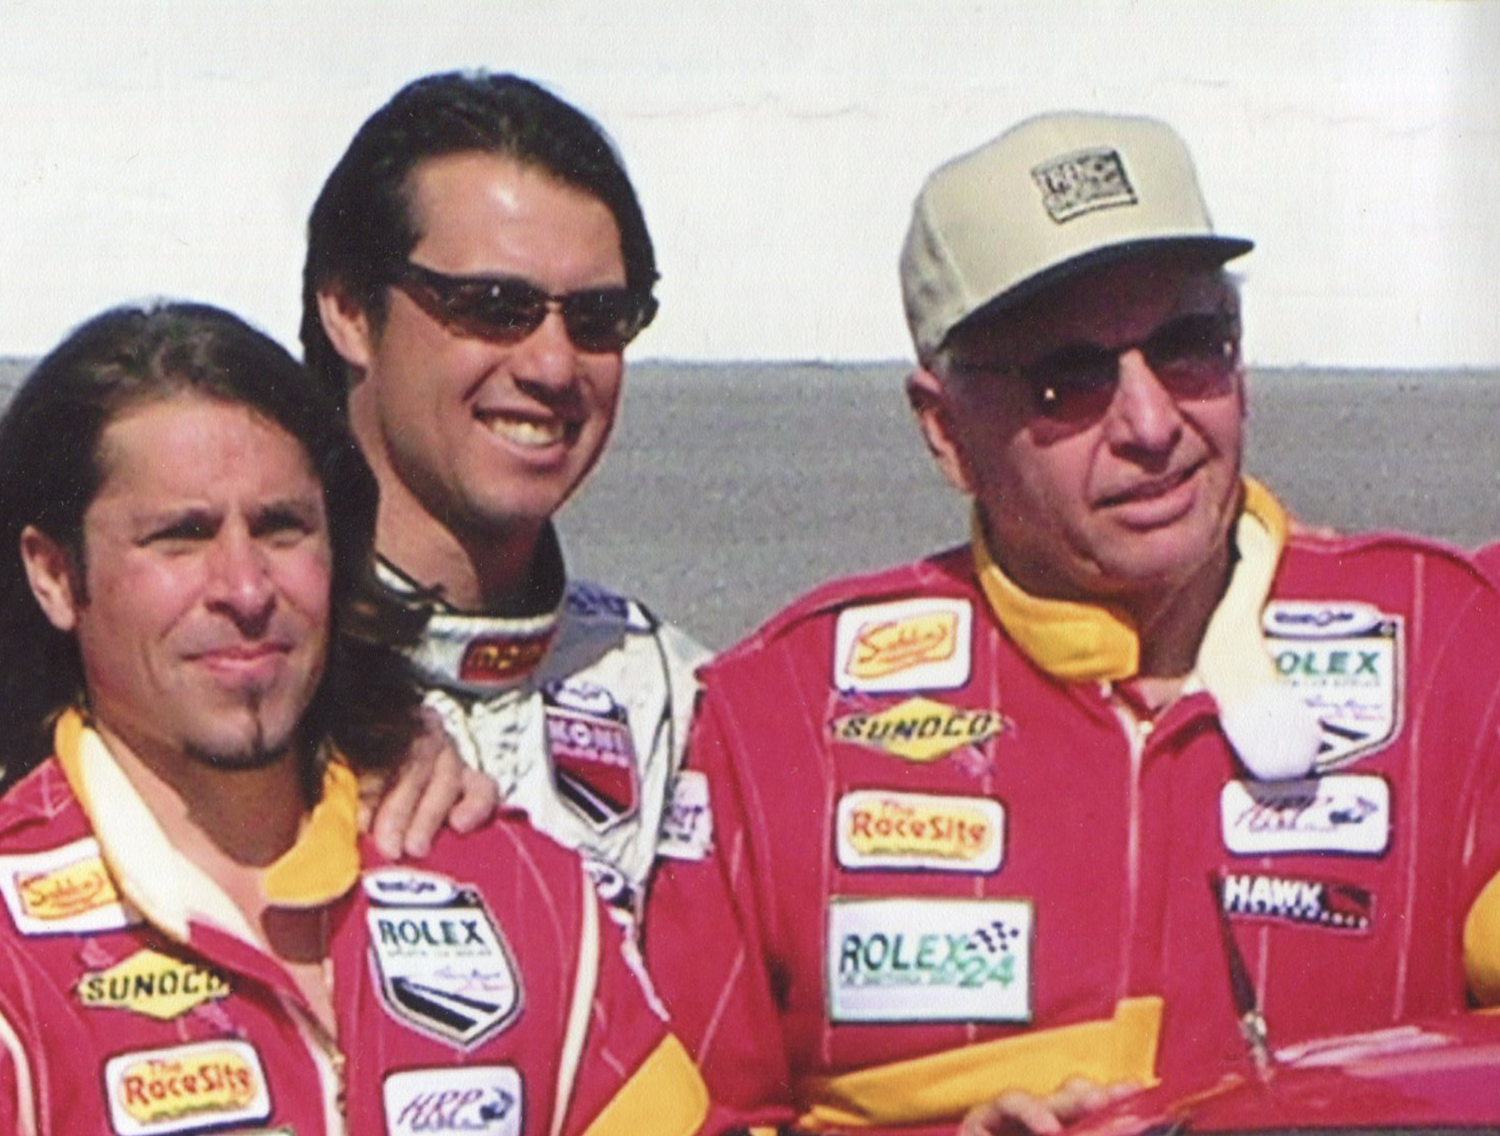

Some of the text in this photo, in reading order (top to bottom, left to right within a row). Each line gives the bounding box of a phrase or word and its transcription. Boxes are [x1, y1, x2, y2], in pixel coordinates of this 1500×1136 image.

[1274, 650, 1381, 676] OLEX
[842, 714, 993, 742] SUNOCO
[851, 809, 987, 844] RaceSite
[1223, 873, 1324, 919] HAWK
[377, 917, 486, 946] ROLEX
[839, 932, 967, 975] ROLEX
[956, 954, 1017, 991] 24
[86, 968, 222, 1002] SUNOCO
[124, 1062, 252, 1106] RaceSite
